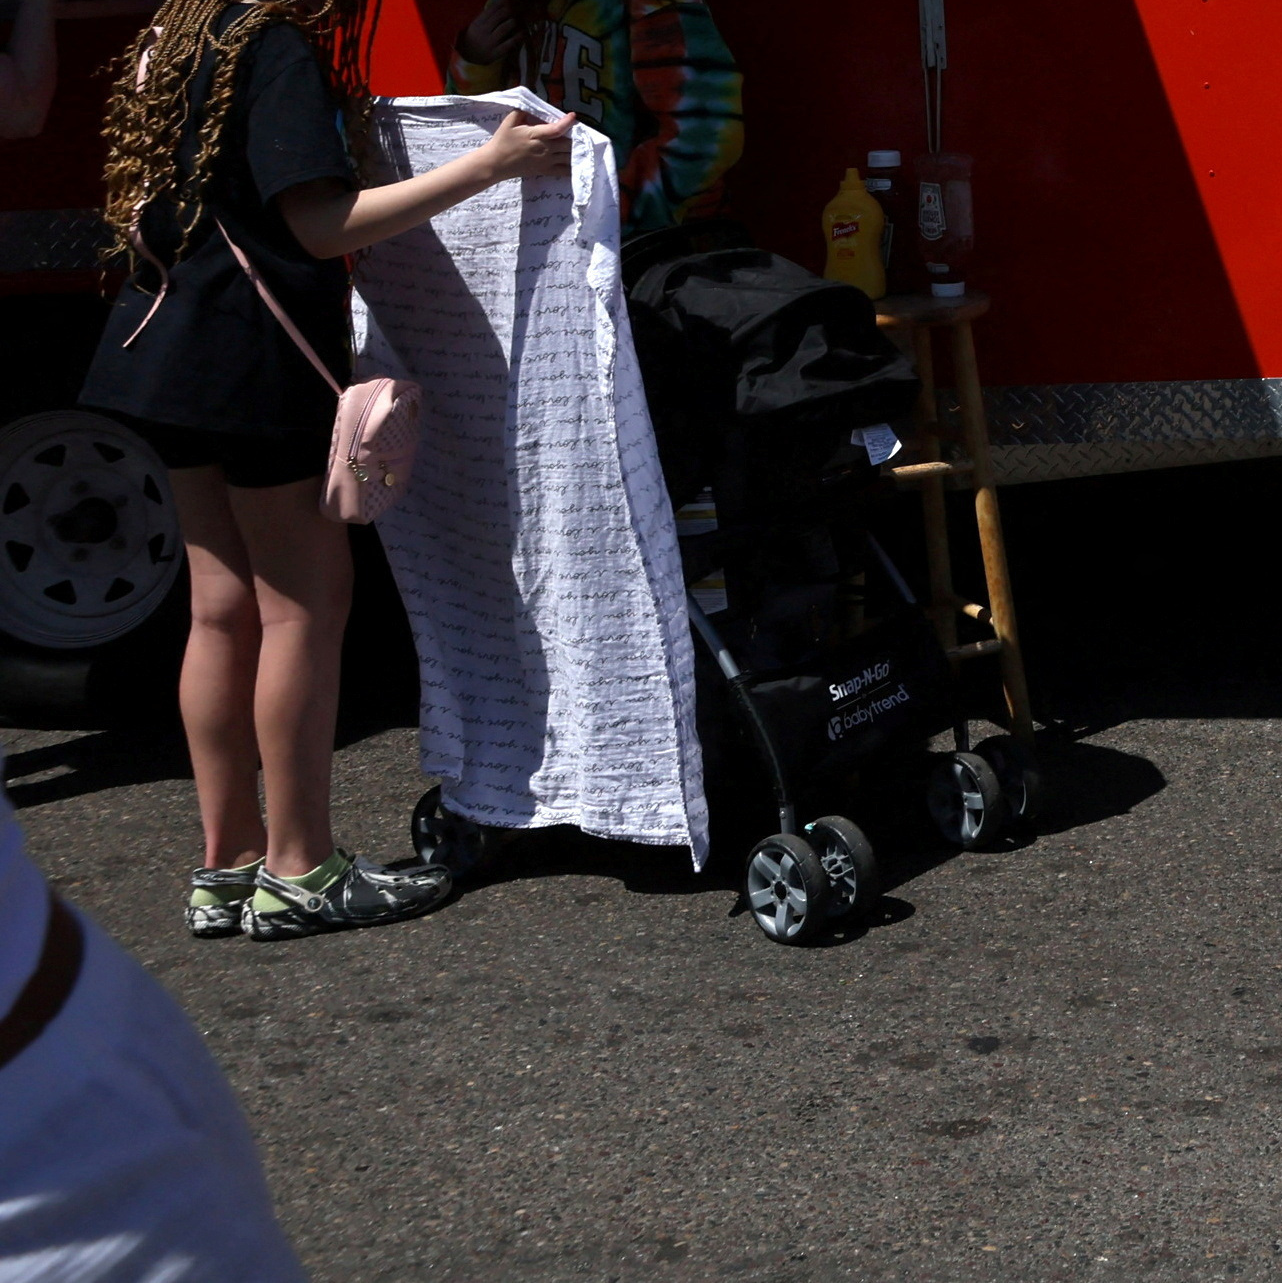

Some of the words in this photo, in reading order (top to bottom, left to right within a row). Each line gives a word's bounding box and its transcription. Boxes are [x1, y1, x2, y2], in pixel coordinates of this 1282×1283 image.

[533, 305, 570, 317] love
[561, 329, 597, 340] love
[524, 351, 560, 363] love
[538, 394, 572, 407] love
[829, 662, 890, 702] Snap-N-Go
